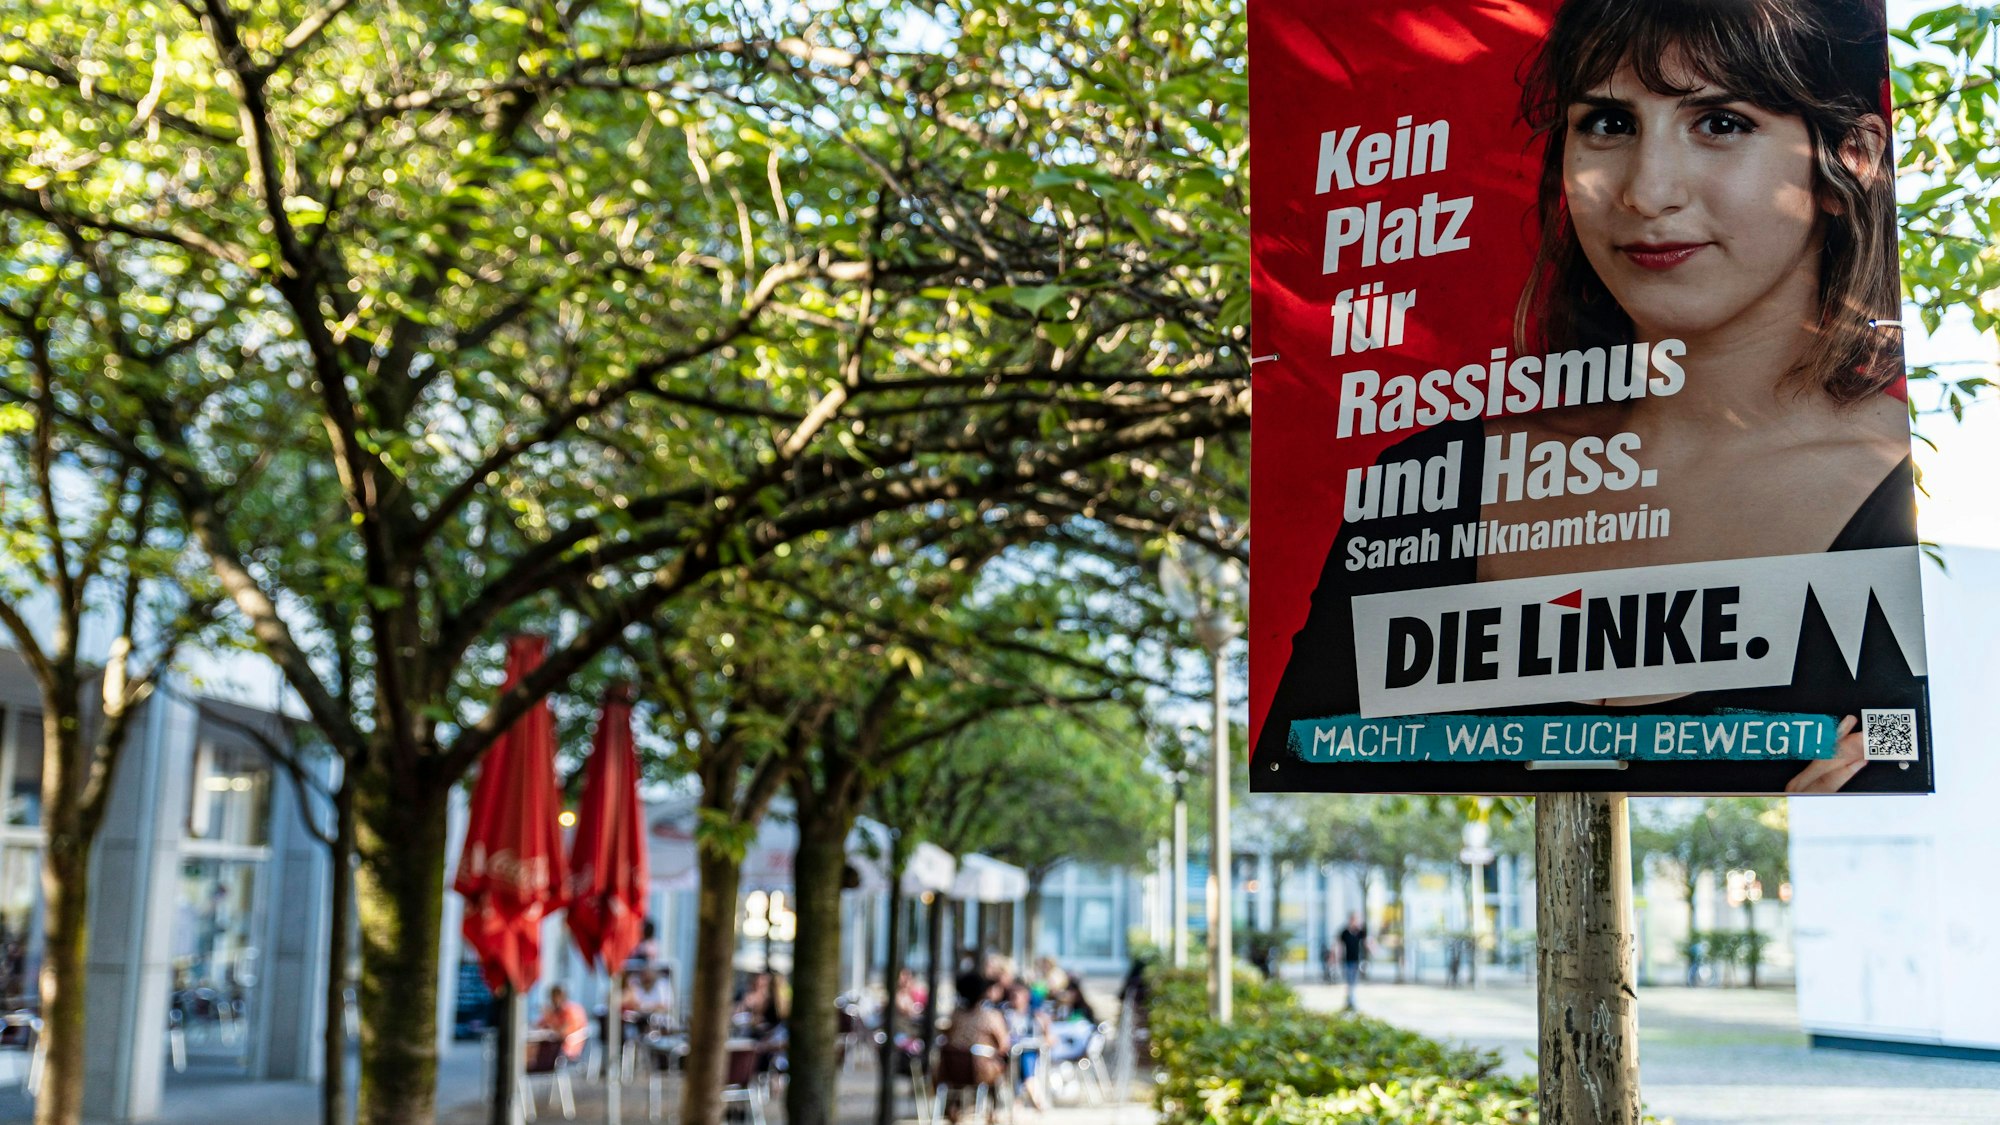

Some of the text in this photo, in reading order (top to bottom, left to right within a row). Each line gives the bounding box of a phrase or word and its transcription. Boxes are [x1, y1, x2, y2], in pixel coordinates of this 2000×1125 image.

[1315, 115, 1450, 195] Kein
[1322, 192, 1474, 275] Platz
[1330, 281, 1417, 357] für
[1336, 338, 1687, 439] Rassismus
[1343, 432, 1659, 523] und Hass.
[1345, 504, 1671, 572] Sarah Niknamtavin
[1385, 607, 1502, 690] DIE
[1312, 720, 1823, 761] MACHT, WAS EUCH BEWEGT!
